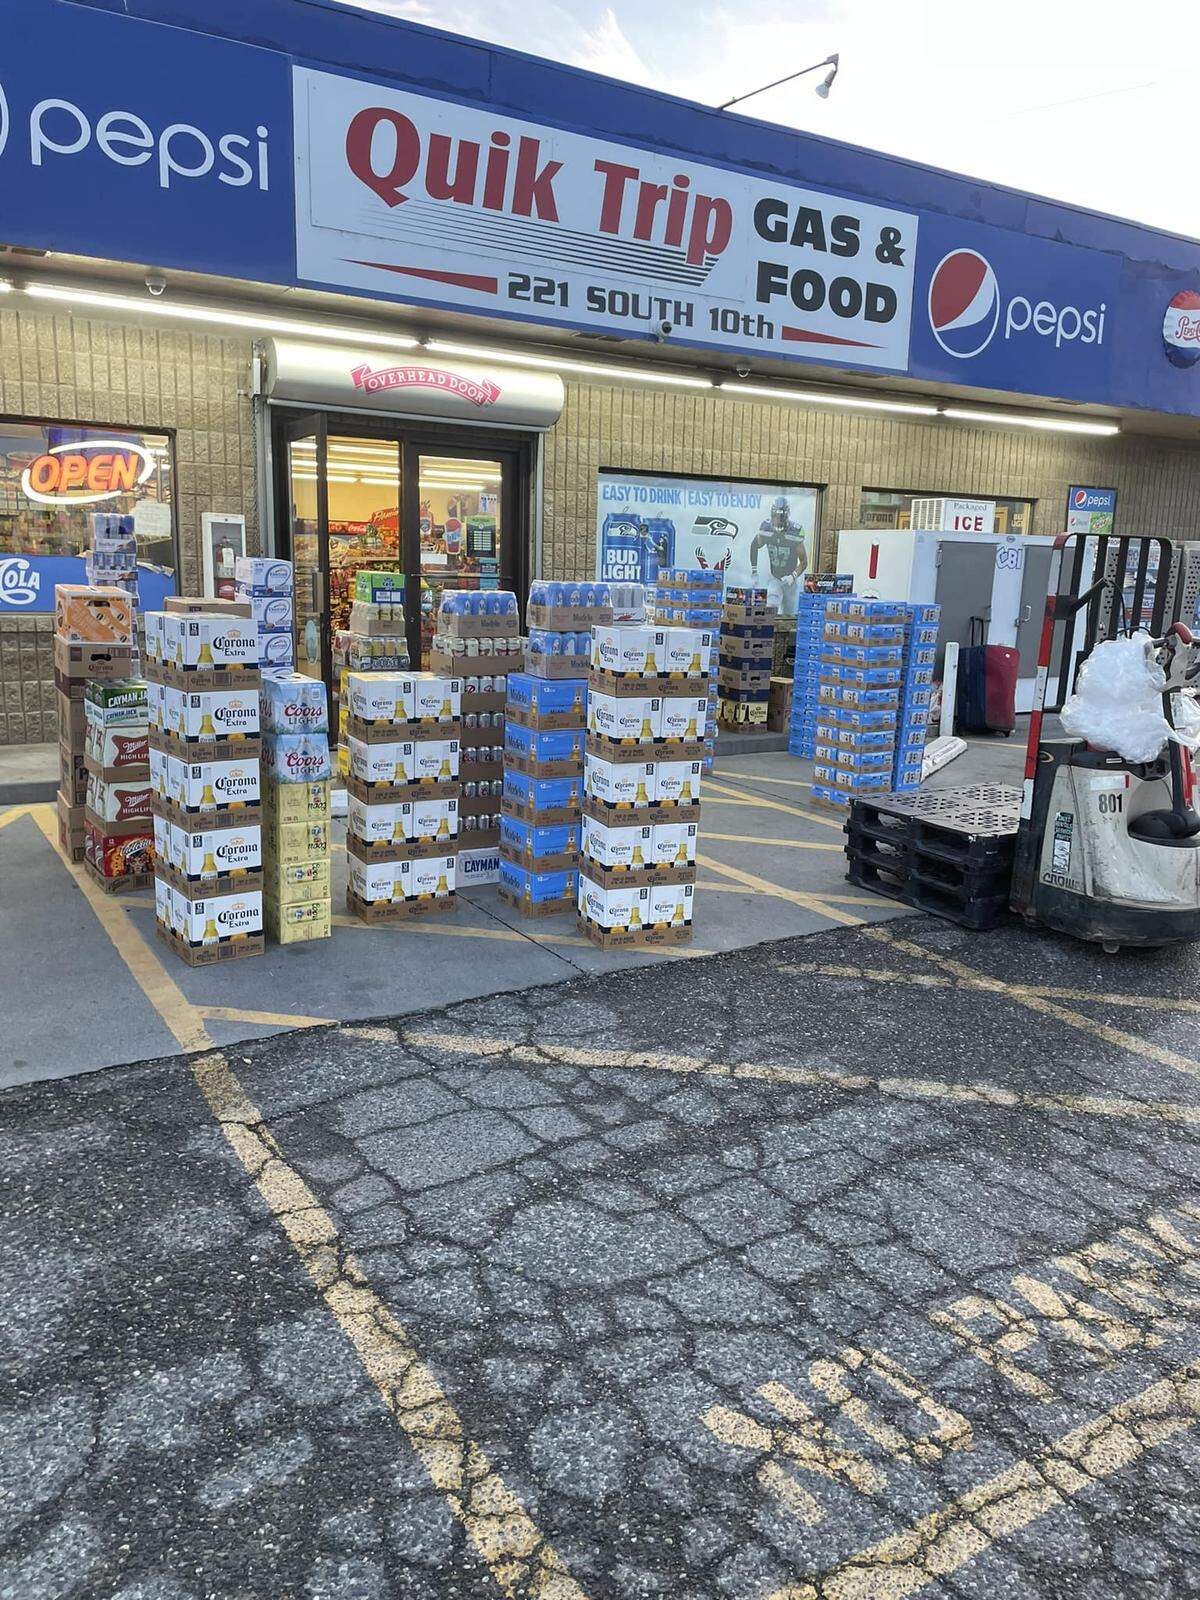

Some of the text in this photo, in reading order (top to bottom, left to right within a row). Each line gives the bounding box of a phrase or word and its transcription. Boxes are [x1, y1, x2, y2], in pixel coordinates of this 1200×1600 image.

[30, 98, 271, 190] pepsi
[345, 107, 733, 265] Quik Trip
[753, 198, 906, 266] GAS &
[755, 262, 898, 323] FOOD
[508, 272, 774, 340] 221 SOUTH 10th
[1005, 296, 1107, 347] pepsi
[368, 370, 484, 403] OVERHEAD DOOR
[31, 455, 139, 492] OPEN
[602, 484, 762, 509] EASY TO DRINK EASY TO ENJOY
[1087, 495, 1111, 507] pepsi
[954, 516, 984, 532] ICE
[606, 549, 639, 564] BUD
[602, 564, 641, 580] LIGHT
[213, 636, 256, 651] Corona
[223, 648, 246, 656] Extra
[108, 691, 138, 708] CAYMAN
[214, 707, 257, 721] Corona
[284, 703, 323, 717] Coors
[288, 717, 320, 725] LIGHT
[286, 752, 324, 767] Coors
[290, 766, 321, 775] LIGHT
[215, 776, 257, 790] Corona
[1098, 793, 1123, 813] 801
[216, 843, 258, 858] Corona
[227, 855, 248, 863] Extra
[464, 858, 500, 873] CAYMAN
[217, 908, 259, 923] Corona
[229, 920, 250, 928] Extra
[700, 1345, 974, 1527] NO
